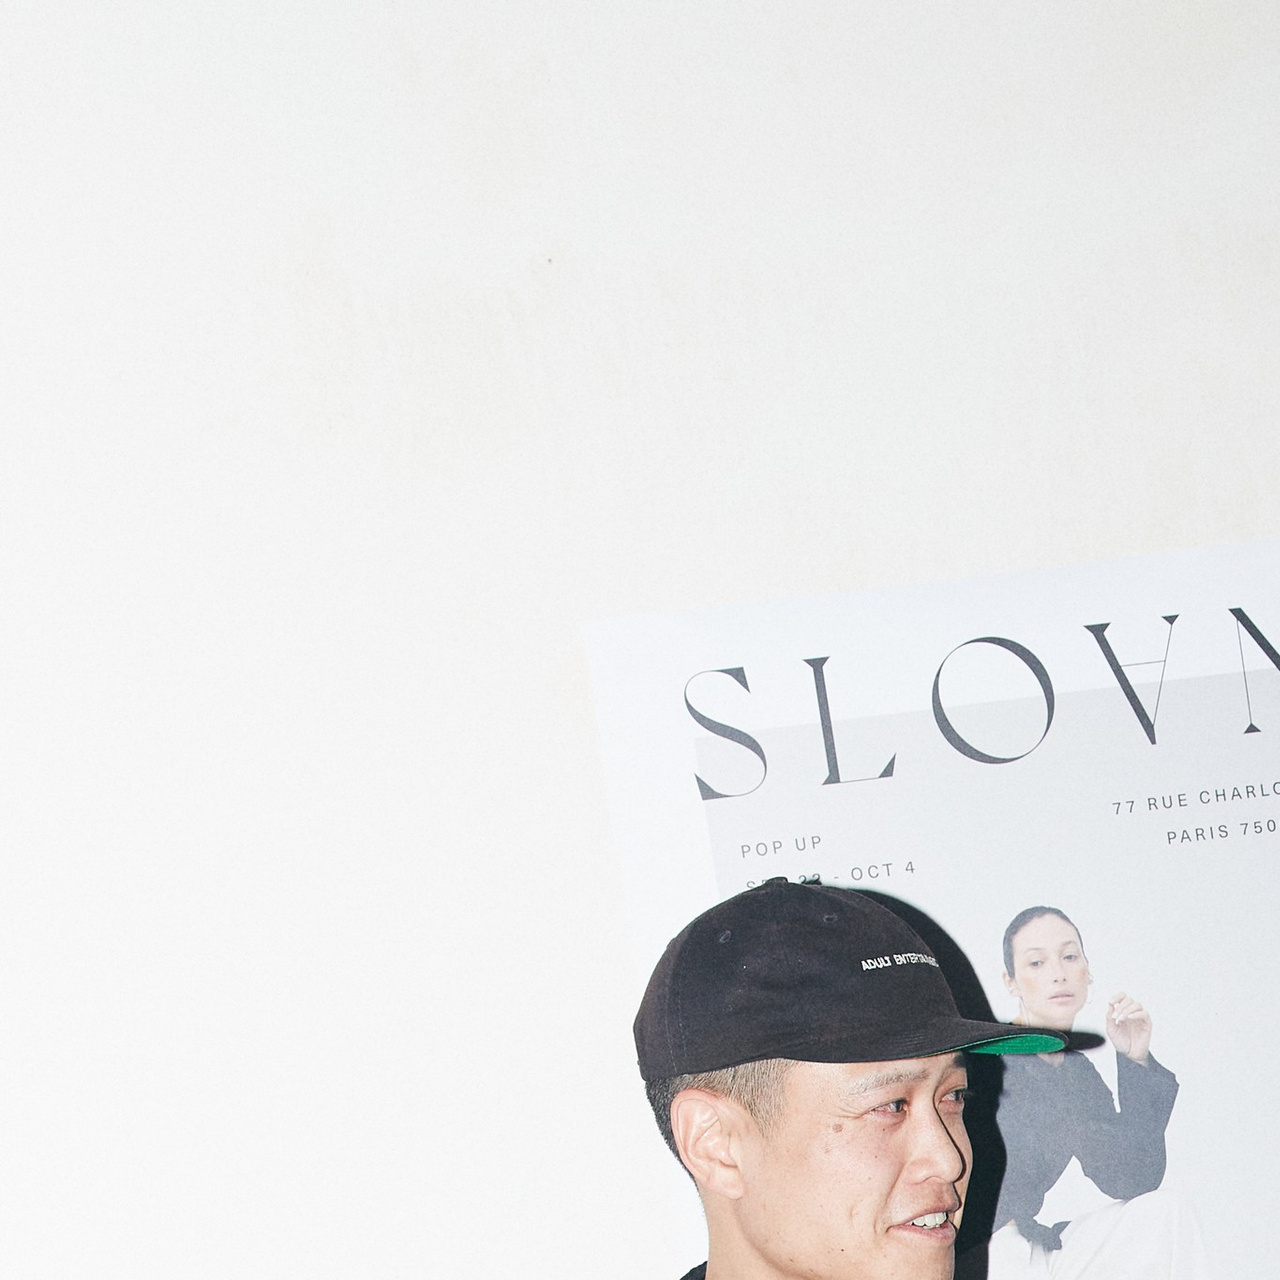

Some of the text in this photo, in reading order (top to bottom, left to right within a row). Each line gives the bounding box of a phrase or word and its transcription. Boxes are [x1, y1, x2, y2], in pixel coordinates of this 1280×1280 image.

[1112, 801, 1135, 816] 77
[1147, 793, 1188, 811] RUE
[1167, 825, 1229, 845] PARIS
[741, 835, 822, 859] POP UP
[850, 862, 893, 881] OCT
[905, 861, 916, 874] 4
[861, 956, 891, 971] ADULT
